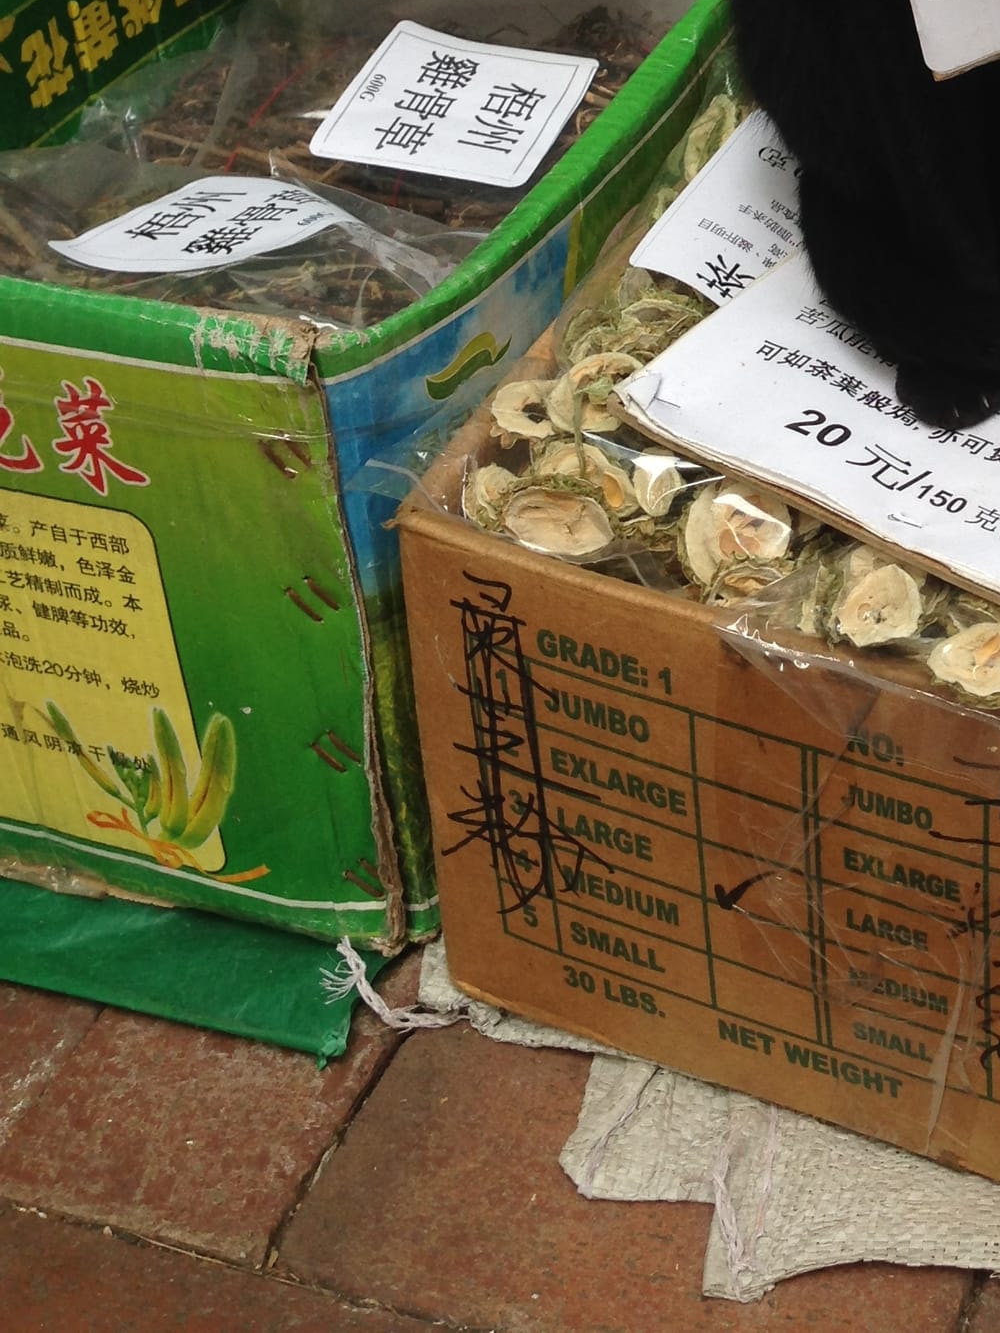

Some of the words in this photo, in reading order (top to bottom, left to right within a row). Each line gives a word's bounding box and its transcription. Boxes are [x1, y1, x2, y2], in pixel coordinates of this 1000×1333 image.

[457, 82, 546, 154] 梧州
[124, 191, 247, 241] 梧州
[696, 254, 755, 298] 茶
[784, 409, 853, 448] 20
[0, 651, 160, 699] 泡洗20分钟、烧炒
[537, 629, 650, 688] GRADE:
[658, 667, 673, 695] 1
[544, 690, 650, 743] JUMBO
[550, 748, 688, 817] EXLARGE
[841, 784, 933, 831] JUMBO
[557, 807, 654, 862] LARGE
[562, 865, 680, 927] MEDIUM
[842, 847, 960, 904] EXLARGE
[523, 905, 538, 930] 5
[570, 922, 666, 973] SMALL
[845, 908, 929, 952] LARGE
[562, 965, 596, 995] 30
[604, 980, 667, 1019] LBS.
[849, 968, 948, 1016] MEDIUM
[717, 1018, 774, 1056] NET
[784, 1042, 903, 1099] WEIGHT
[852, 1020, 933, 1064] SMALL
